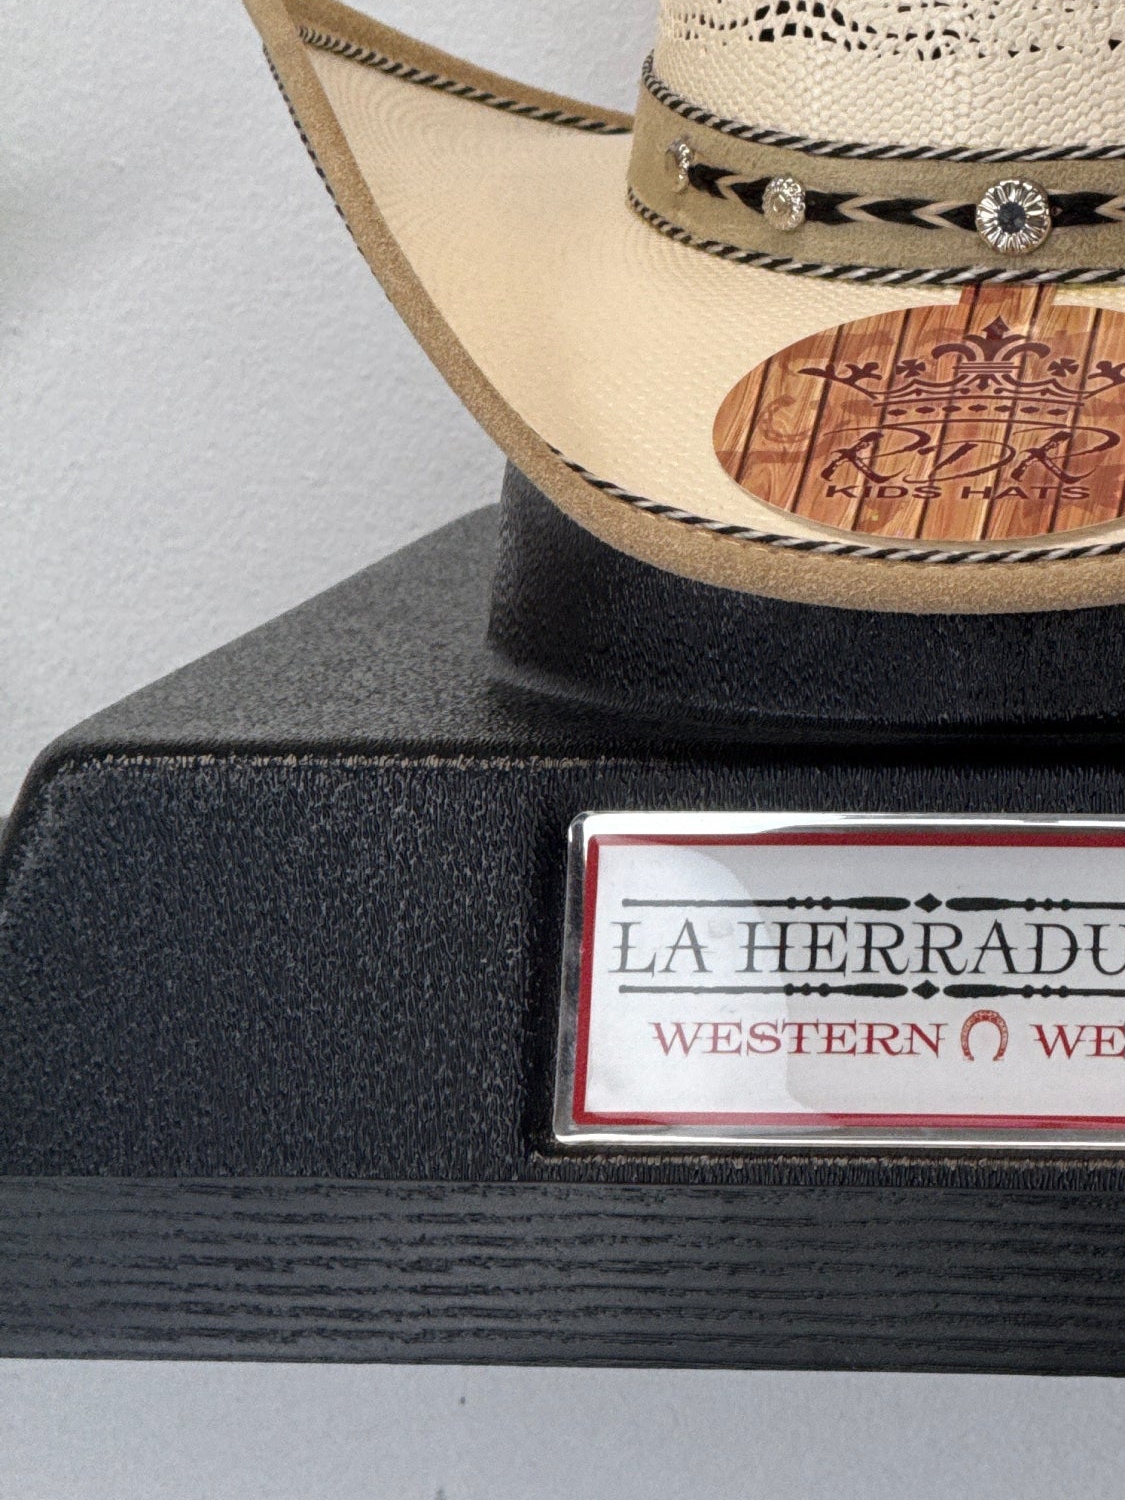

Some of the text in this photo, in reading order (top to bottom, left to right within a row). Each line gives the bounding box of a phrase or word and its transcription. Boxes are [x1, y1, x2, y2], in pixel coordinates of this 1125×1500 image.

[826, 484, 1091, 500] KIDS HATS
[611, 918, 712, 977] LA
[650, 1020, 948, 1057] WESTERN
